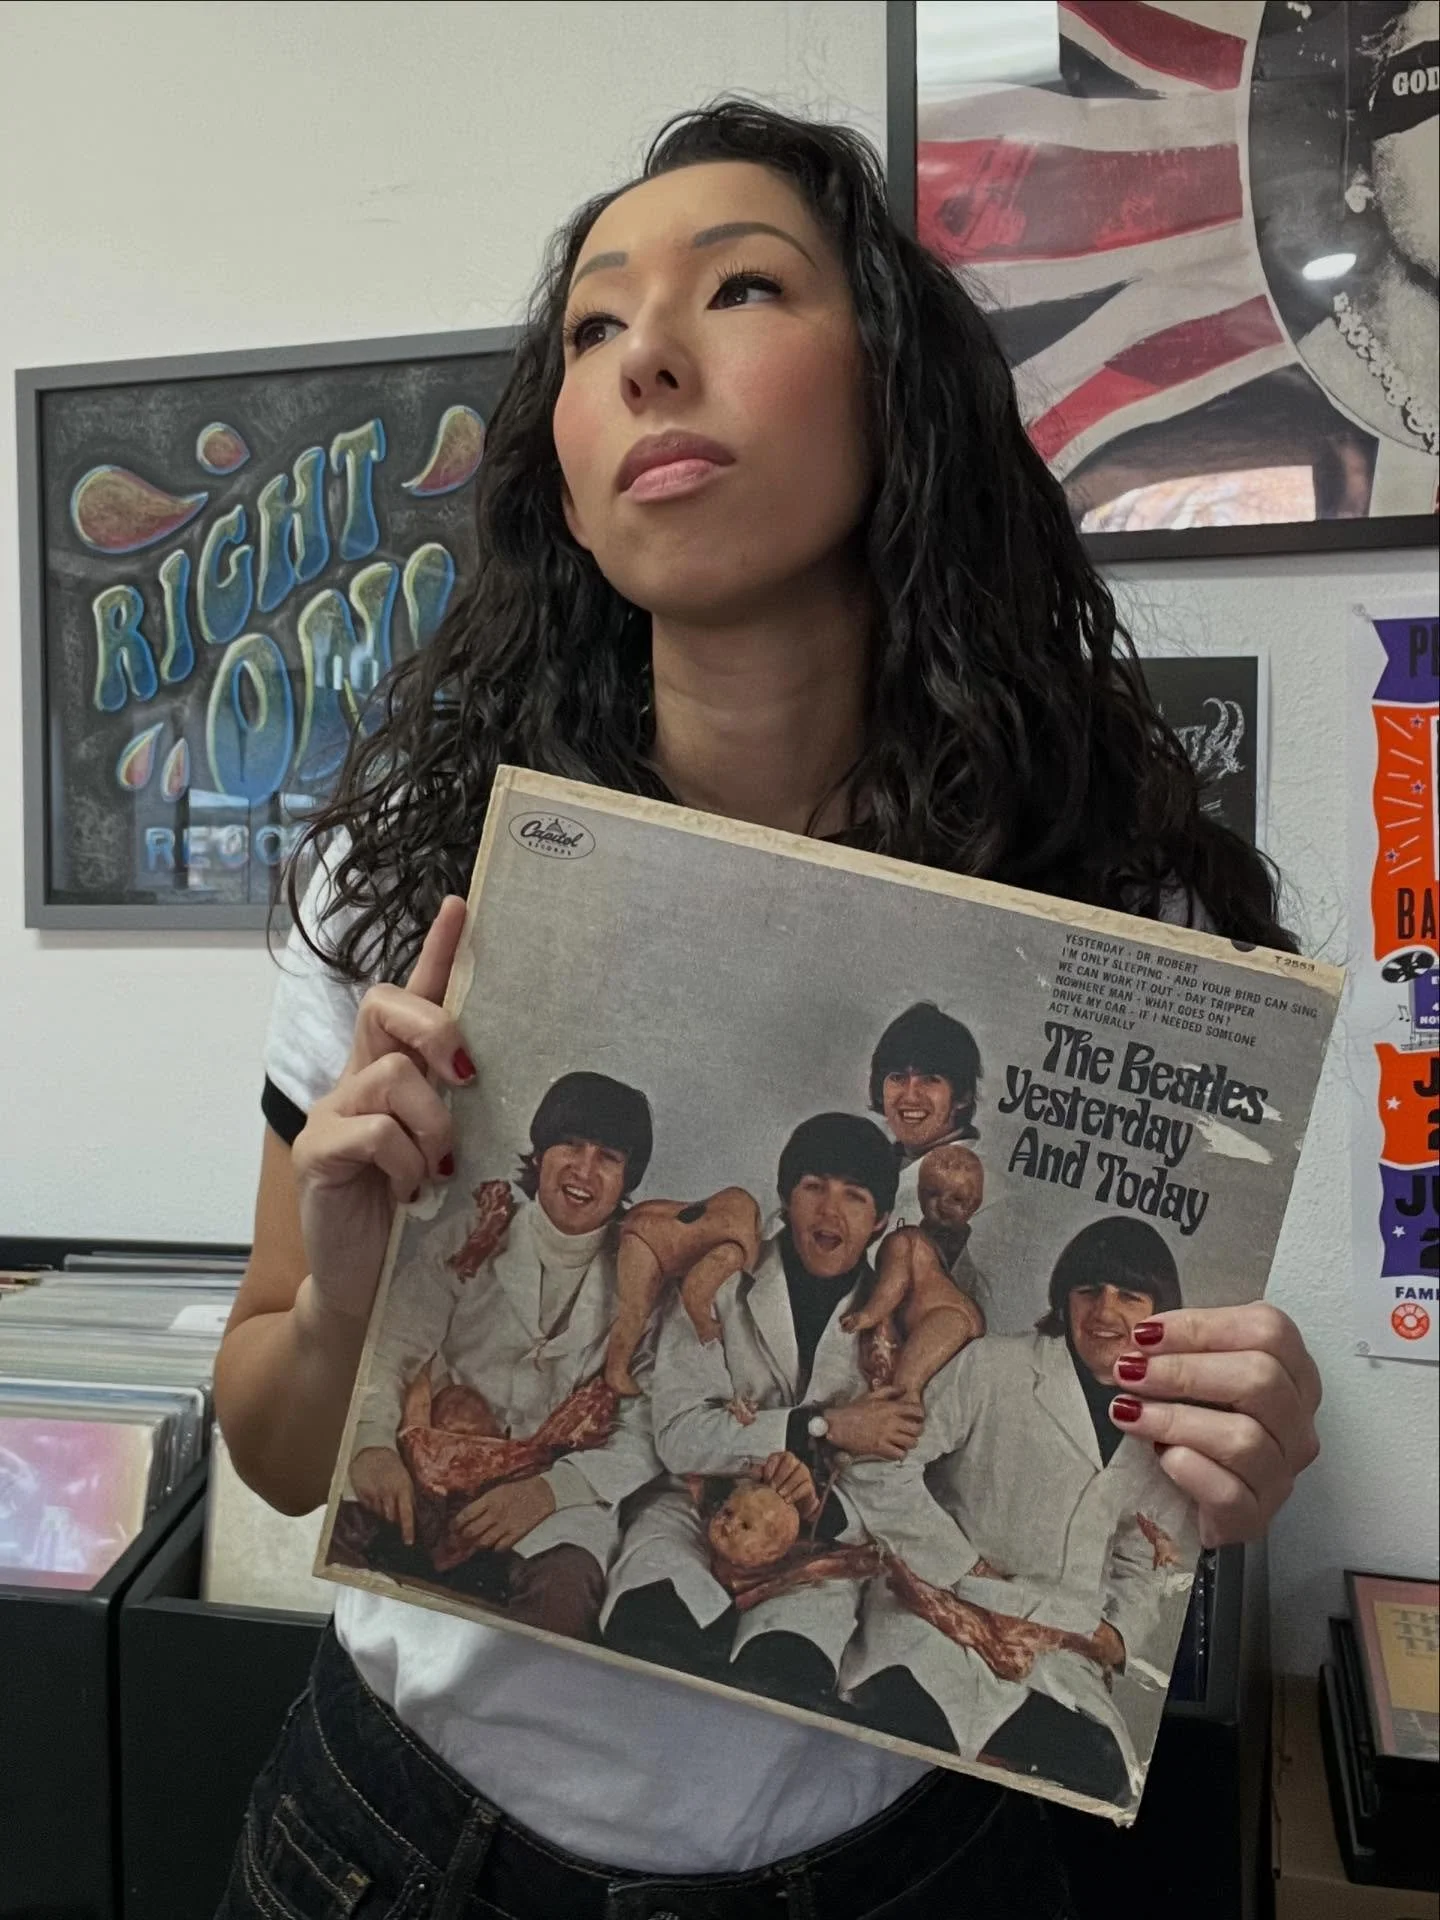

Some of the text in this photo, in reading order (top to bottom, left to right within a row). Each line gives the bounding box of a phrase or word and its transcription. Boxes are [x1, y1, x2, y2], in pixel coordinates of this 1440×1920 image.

[1392, 66, 1439, 96] GOD
[93, 417, 386, 712] RIGHT
[521, 820, 583, 847] Capitol
[1065, 934, 1125, 956] YESTERDAY
[1157, 955, 1199, 974] ROBERT
[1056, 975, 1106, 996] NOWHERE
[1109, 987, 1134, 1002] MAN
[1145, 996, 1174, 1012] WHAT
[1178, 1004, 1205, 1020] GOES
[1059, 961, 1256, 1018] WE CAN WORK IT OUT DAY TRIPPER
[1062, 947, 1318, 1019] I'M ONLY SLEEPING AND YOUR BIRD CAN SING
[1049, 1001, 1136, 1031] ACT NATURALLY
[1053, 988, 1083, 1004] DRIVE
[1086, 996, 1102, 1009] MY
[1105, 1001, 1127, 1015] CAR
[1139, 1009, 1150, 1020] IF
[1161, 1015, 1203, 1034] NEEDED
[1205, 1026, 1257, 1047] SOMEONE
[1043, 1021, 1269, 1125] The Beatles
[1008, 1126, 1210, 1236] And Today
